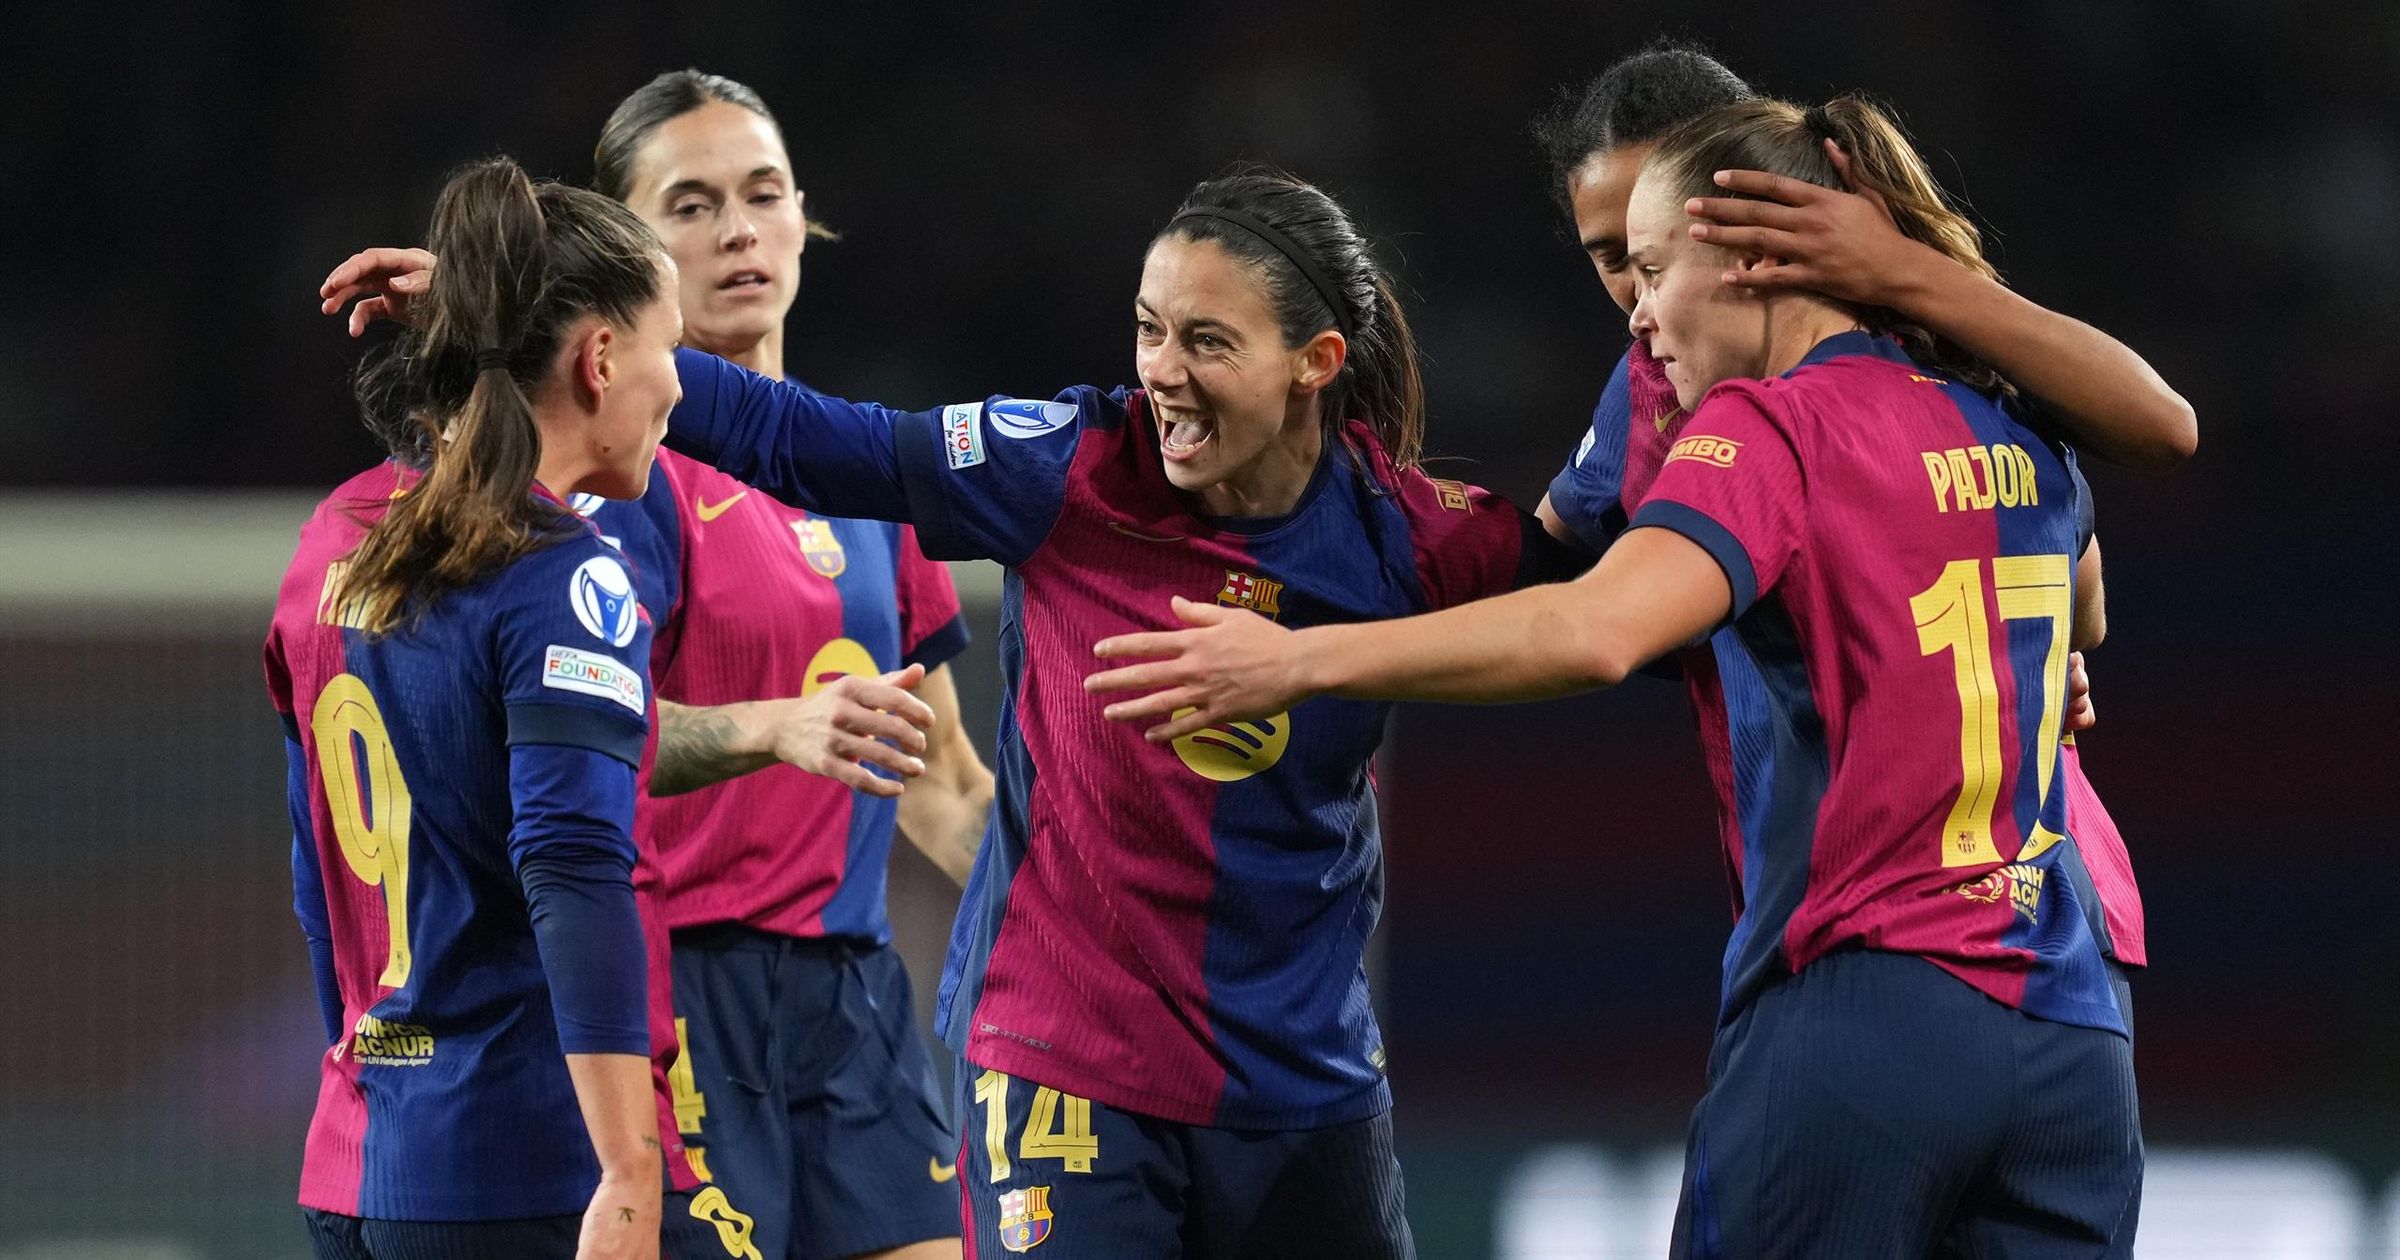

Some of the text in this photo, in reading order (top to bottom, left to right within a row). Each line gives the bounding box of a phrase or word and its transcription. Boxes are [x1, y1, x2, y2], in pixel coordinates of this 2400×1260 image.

[955, 408, 974, 464] ATION
[1672, 439, 1737, 463] MBO
[1920, 443, 2039, 513] PAJOR
[549, 659, 642, 700] FOUNDATION
[1909, 553, 2071, 868] 17
[310, 672, 413, 989] 9
[1999, 864, 2044, 891] UNH
[2009, 879, 2041, 910] ACN
[353, 1034, 435, 1057] ACNUR
[354, 1013, 432, 1037] UNHCR
[975, 1069, 1099, 1184] 14
